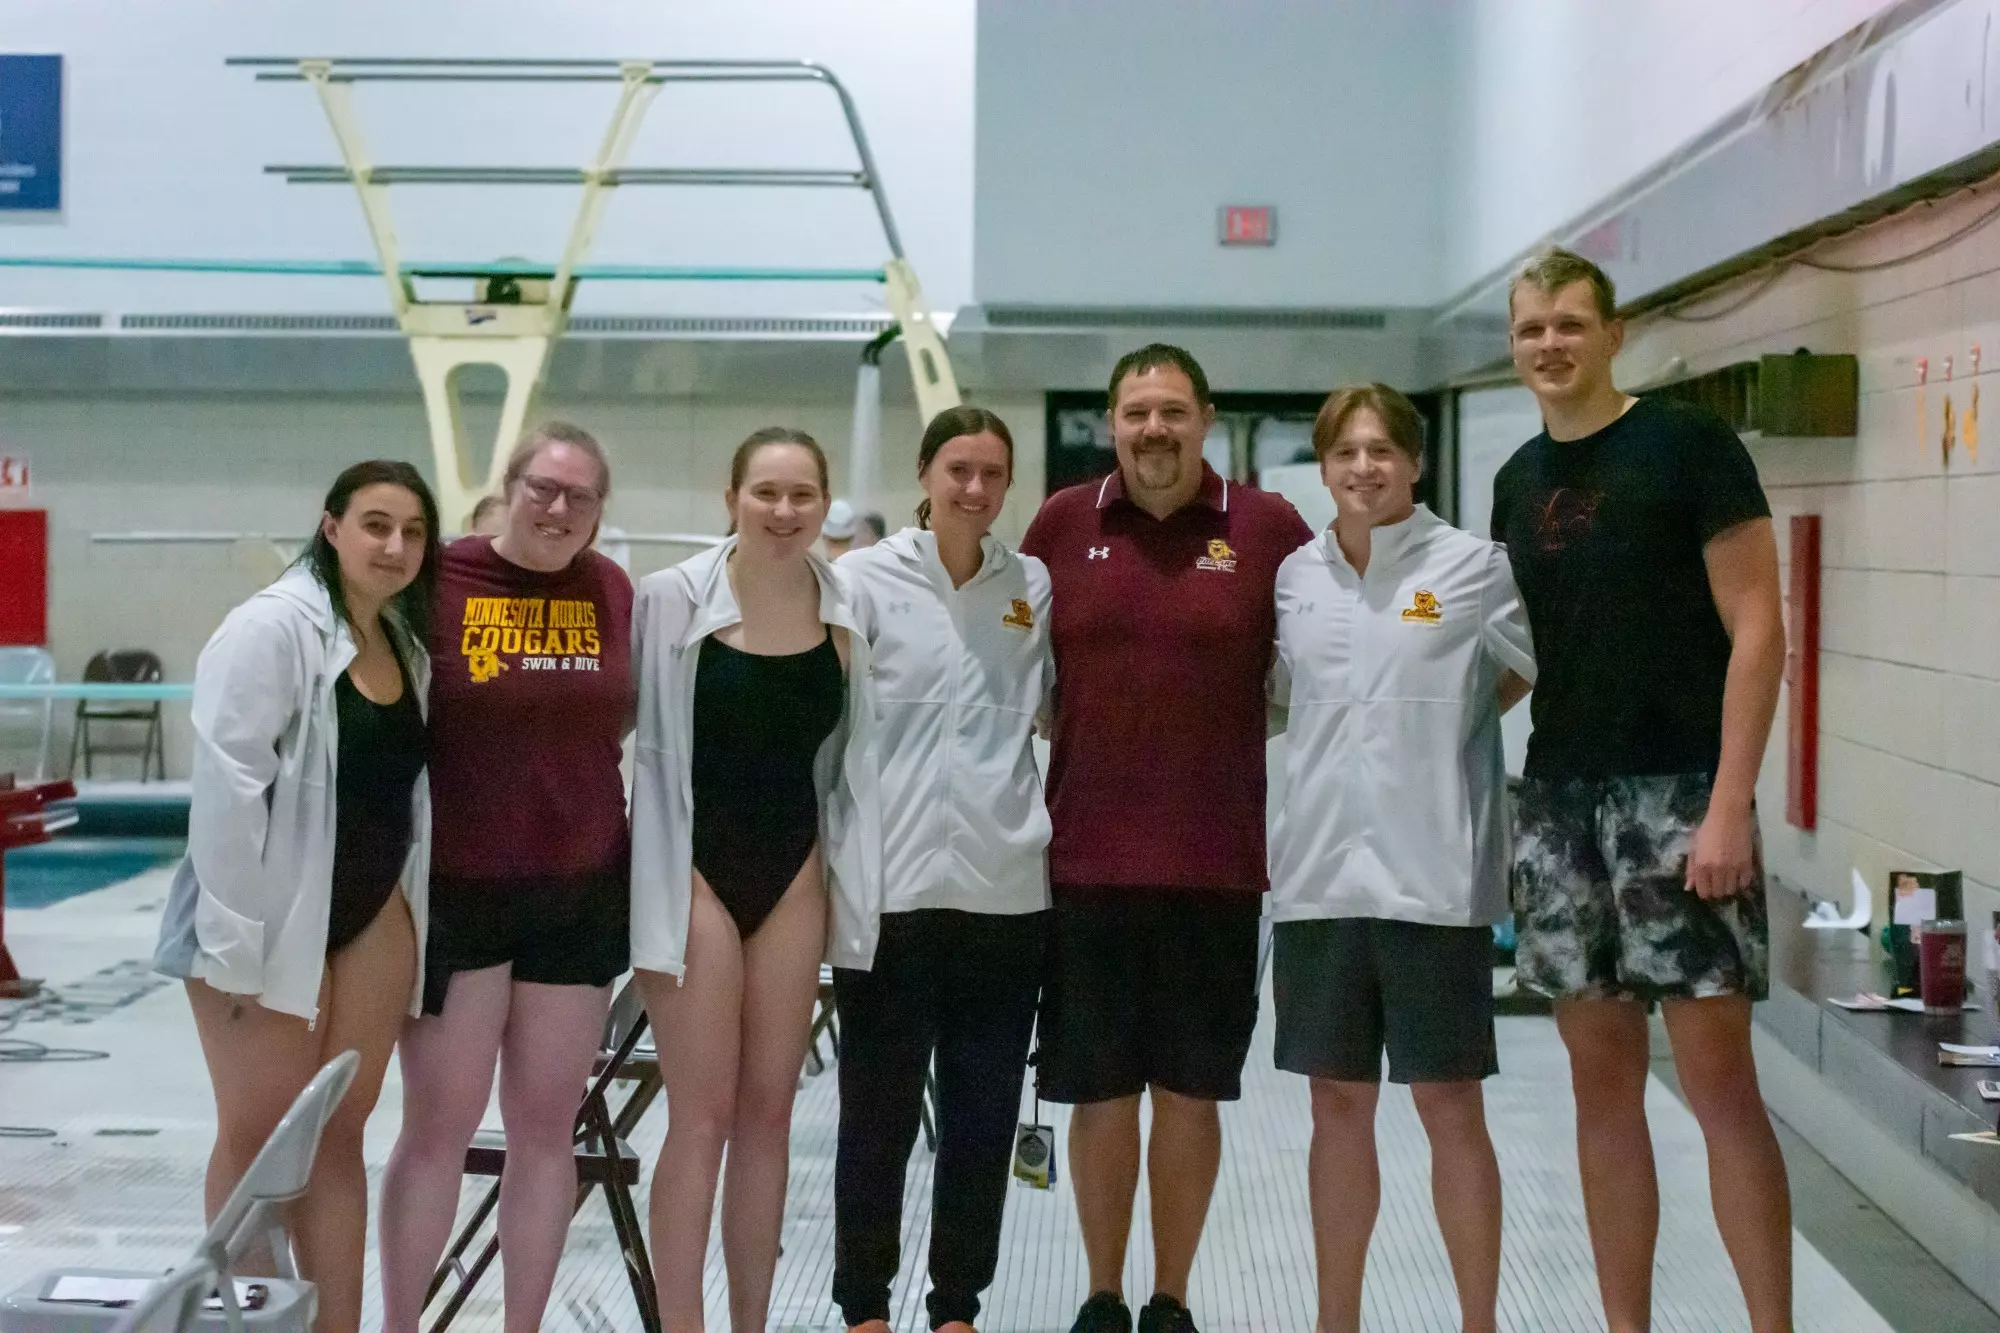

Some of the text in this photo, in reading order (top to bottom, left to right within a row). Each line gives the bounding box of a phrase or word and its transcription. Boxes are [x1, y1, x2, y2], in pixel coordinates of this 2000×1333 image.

[463, 597, 597, 629] MINNESOTA MORRIS
[461, 626, 600, 656] COUGARS
[521, 657, 600, 671] SWIM & DIVE
